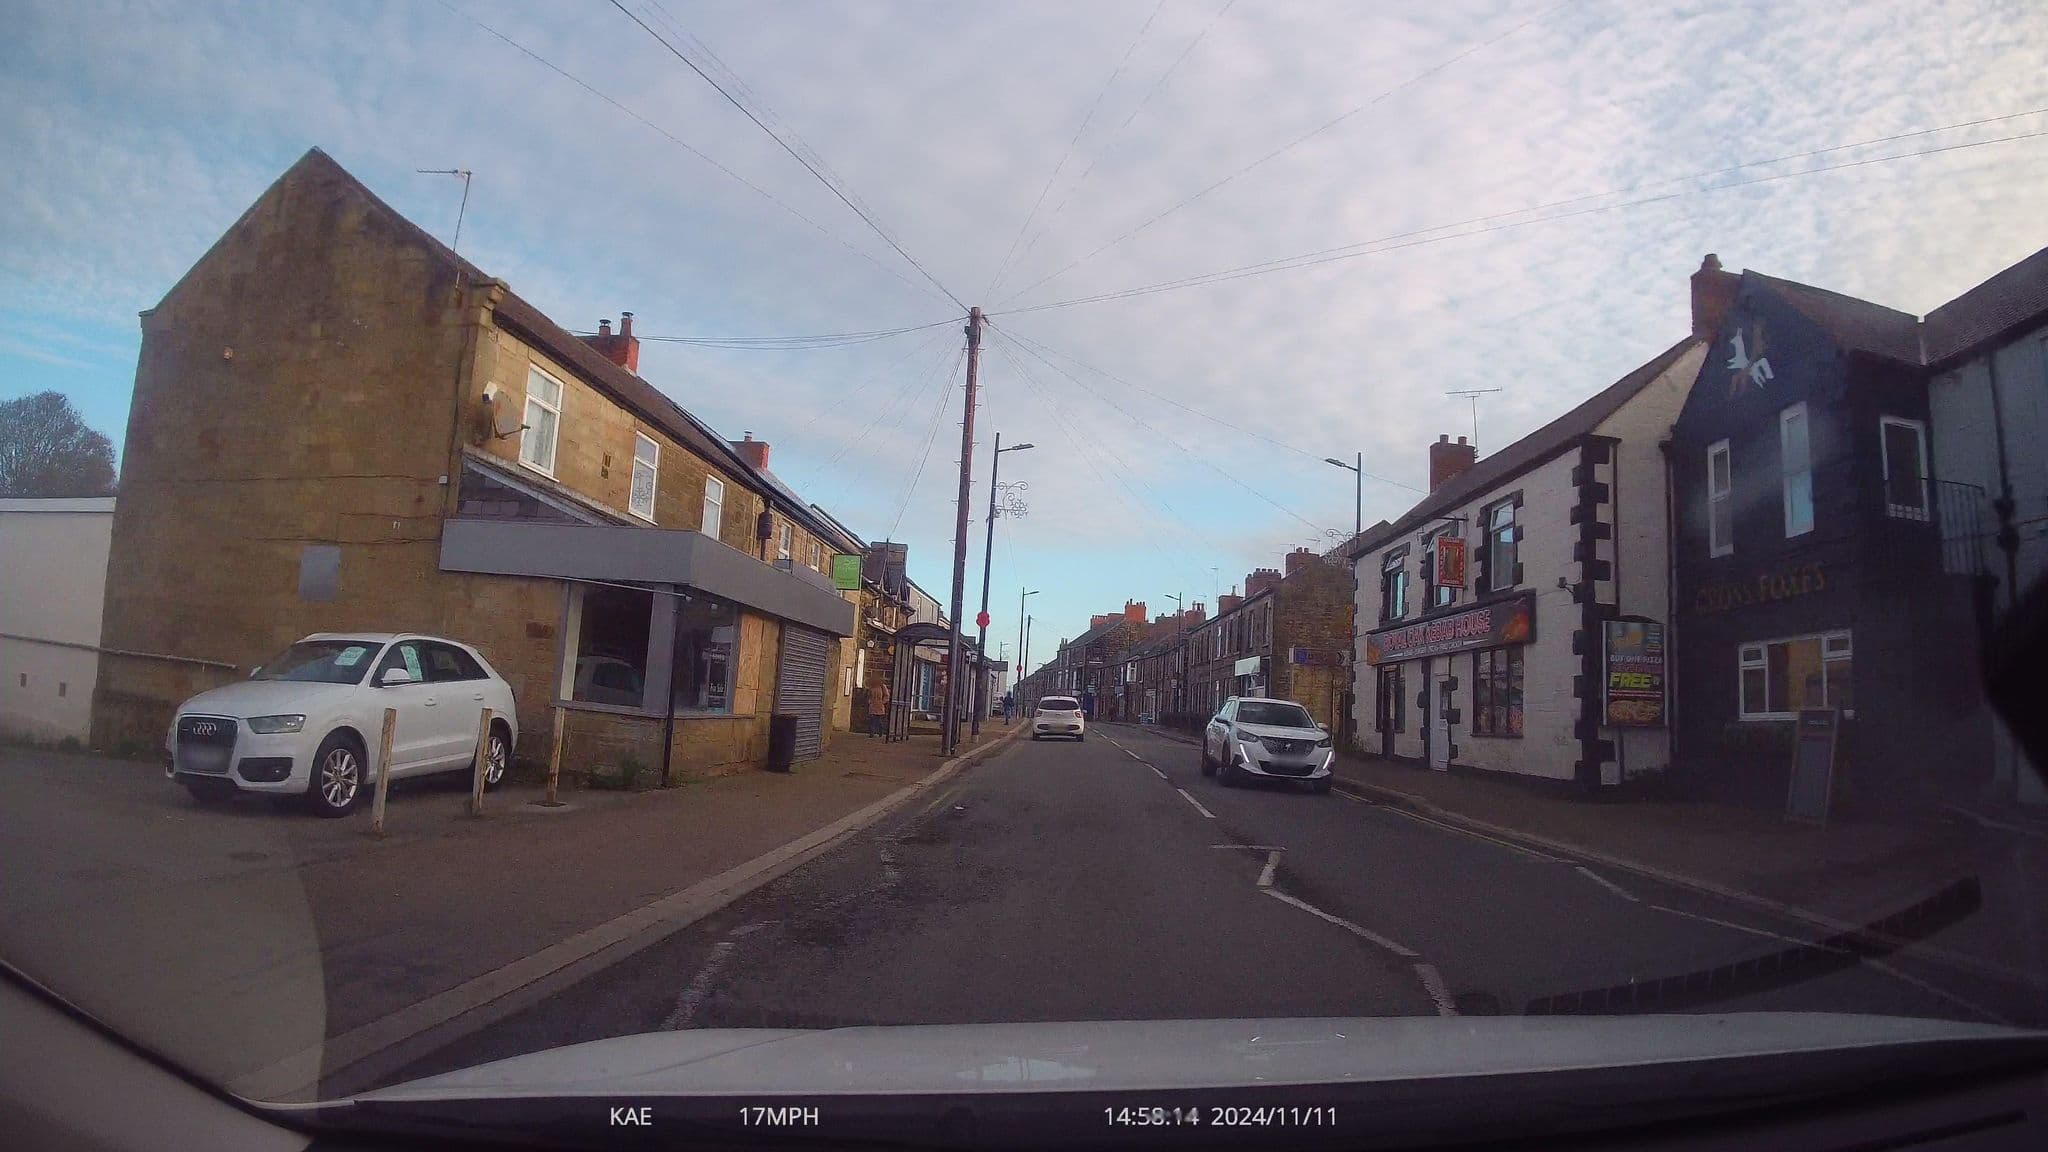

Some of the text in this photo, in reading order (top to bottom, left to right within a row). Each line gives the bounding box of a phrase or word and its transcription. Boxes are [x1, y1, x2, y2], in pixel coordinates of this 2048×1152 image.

[1758, 564, 1825, 603] FOXES
[1383, 631, 1408, 652] ROYAL
[1407, 626, 1426, 648] OAK
[1425, 619, 1455, 643] KEBAB
[1455, 609, 1491, 637] HOUSE
[1609, 671, 1652, 688] FREE
